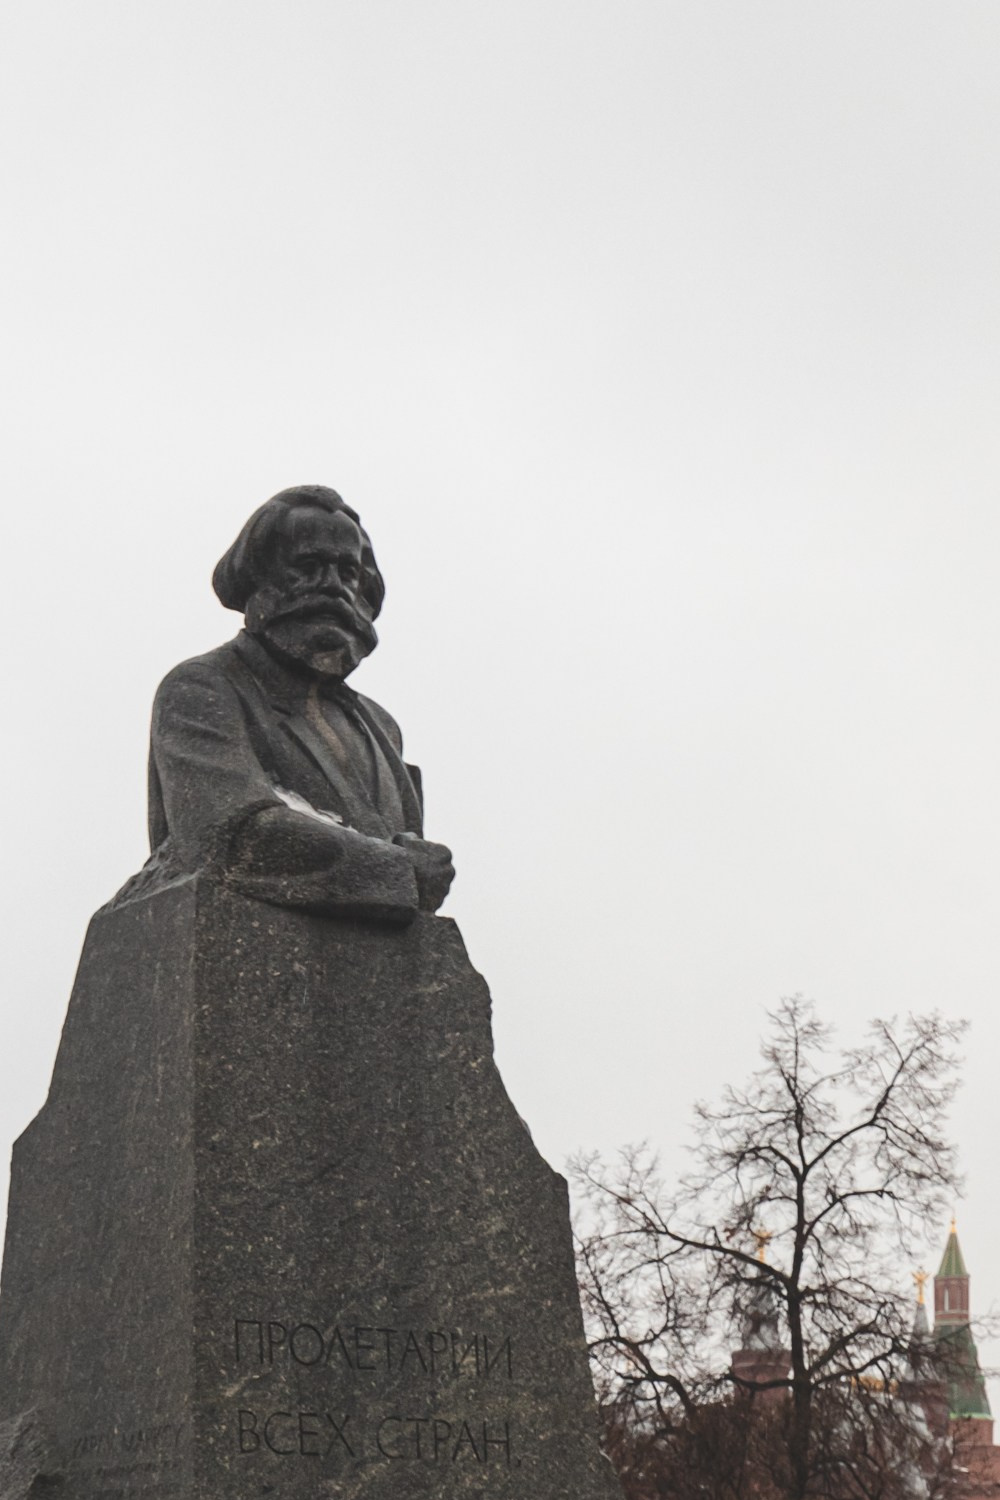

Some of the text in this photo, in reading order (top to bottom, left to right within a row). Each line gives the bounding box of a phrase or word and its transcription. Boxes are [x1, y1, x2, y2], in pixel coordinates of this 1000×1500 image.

[233, 1319, 514, 1379] ПРОЛЕТАРИИ
[237, 1409, 356, 1458] ВСЕХ
[375, 1415, 523, 1468] СТРАН,
